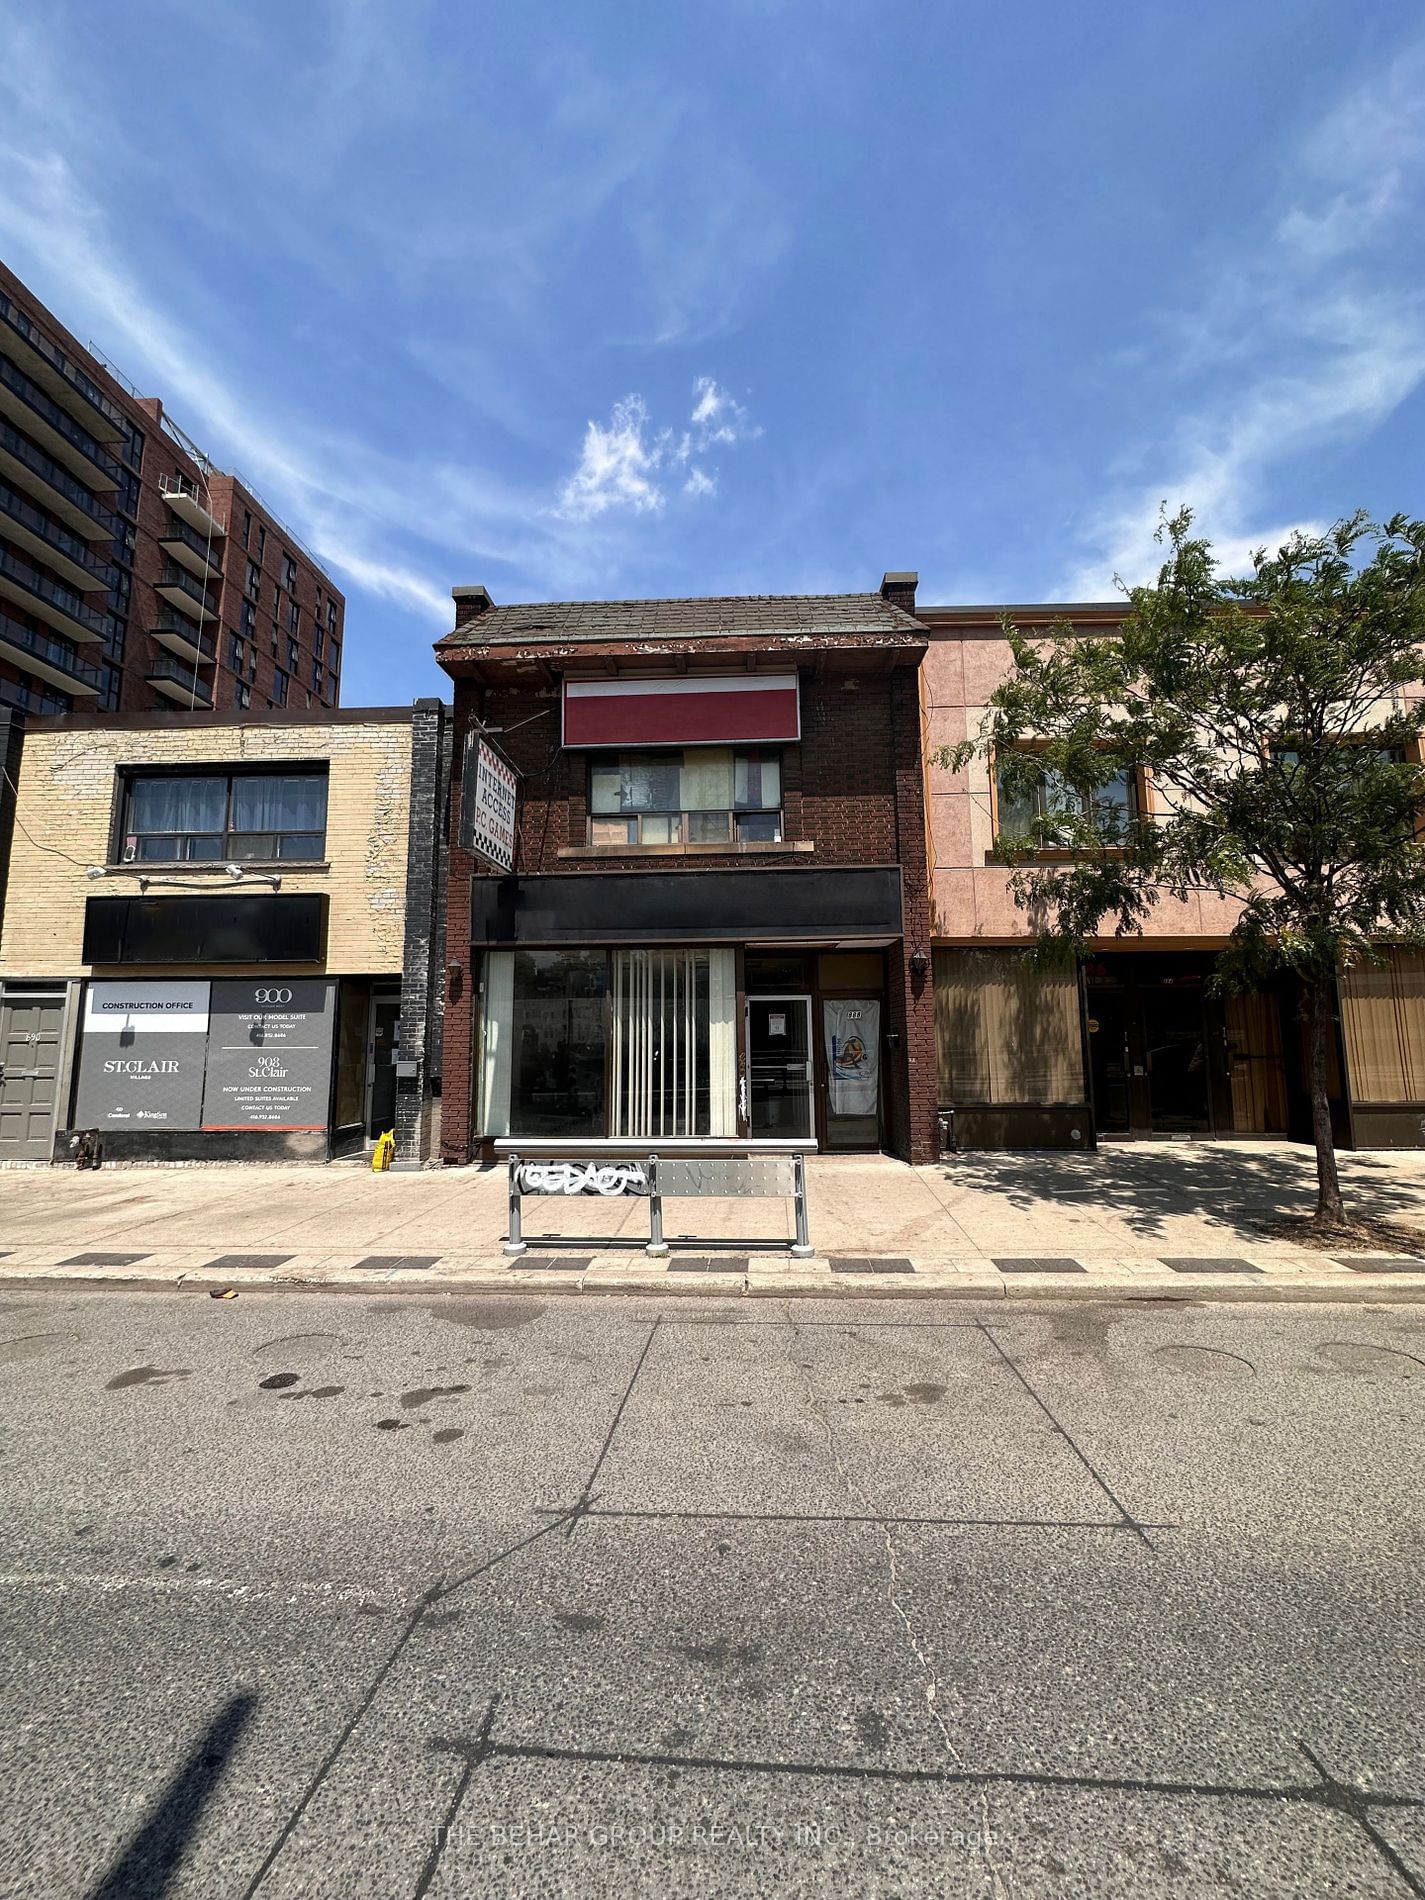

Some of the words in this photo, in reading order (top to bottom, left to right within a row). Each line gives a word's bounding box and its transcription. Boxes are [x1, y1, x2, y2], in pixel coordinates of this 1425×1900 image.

[478, 763, 515, 810] INTERNET
[481, 787, 511, 825] ACCESS
[476, 806, 488, 830] P.C.
[489, 818, 513, 849] GAMES
[254, 987, 293, 1004] 900
[102, 1002, 163, 1010] CONSTRUCTION
[103, 1060, 180, 1073] ST.CLAIR
[258, 1057, 280, 1068] 908
[248, 1067, 288, 1078] St.Clair
